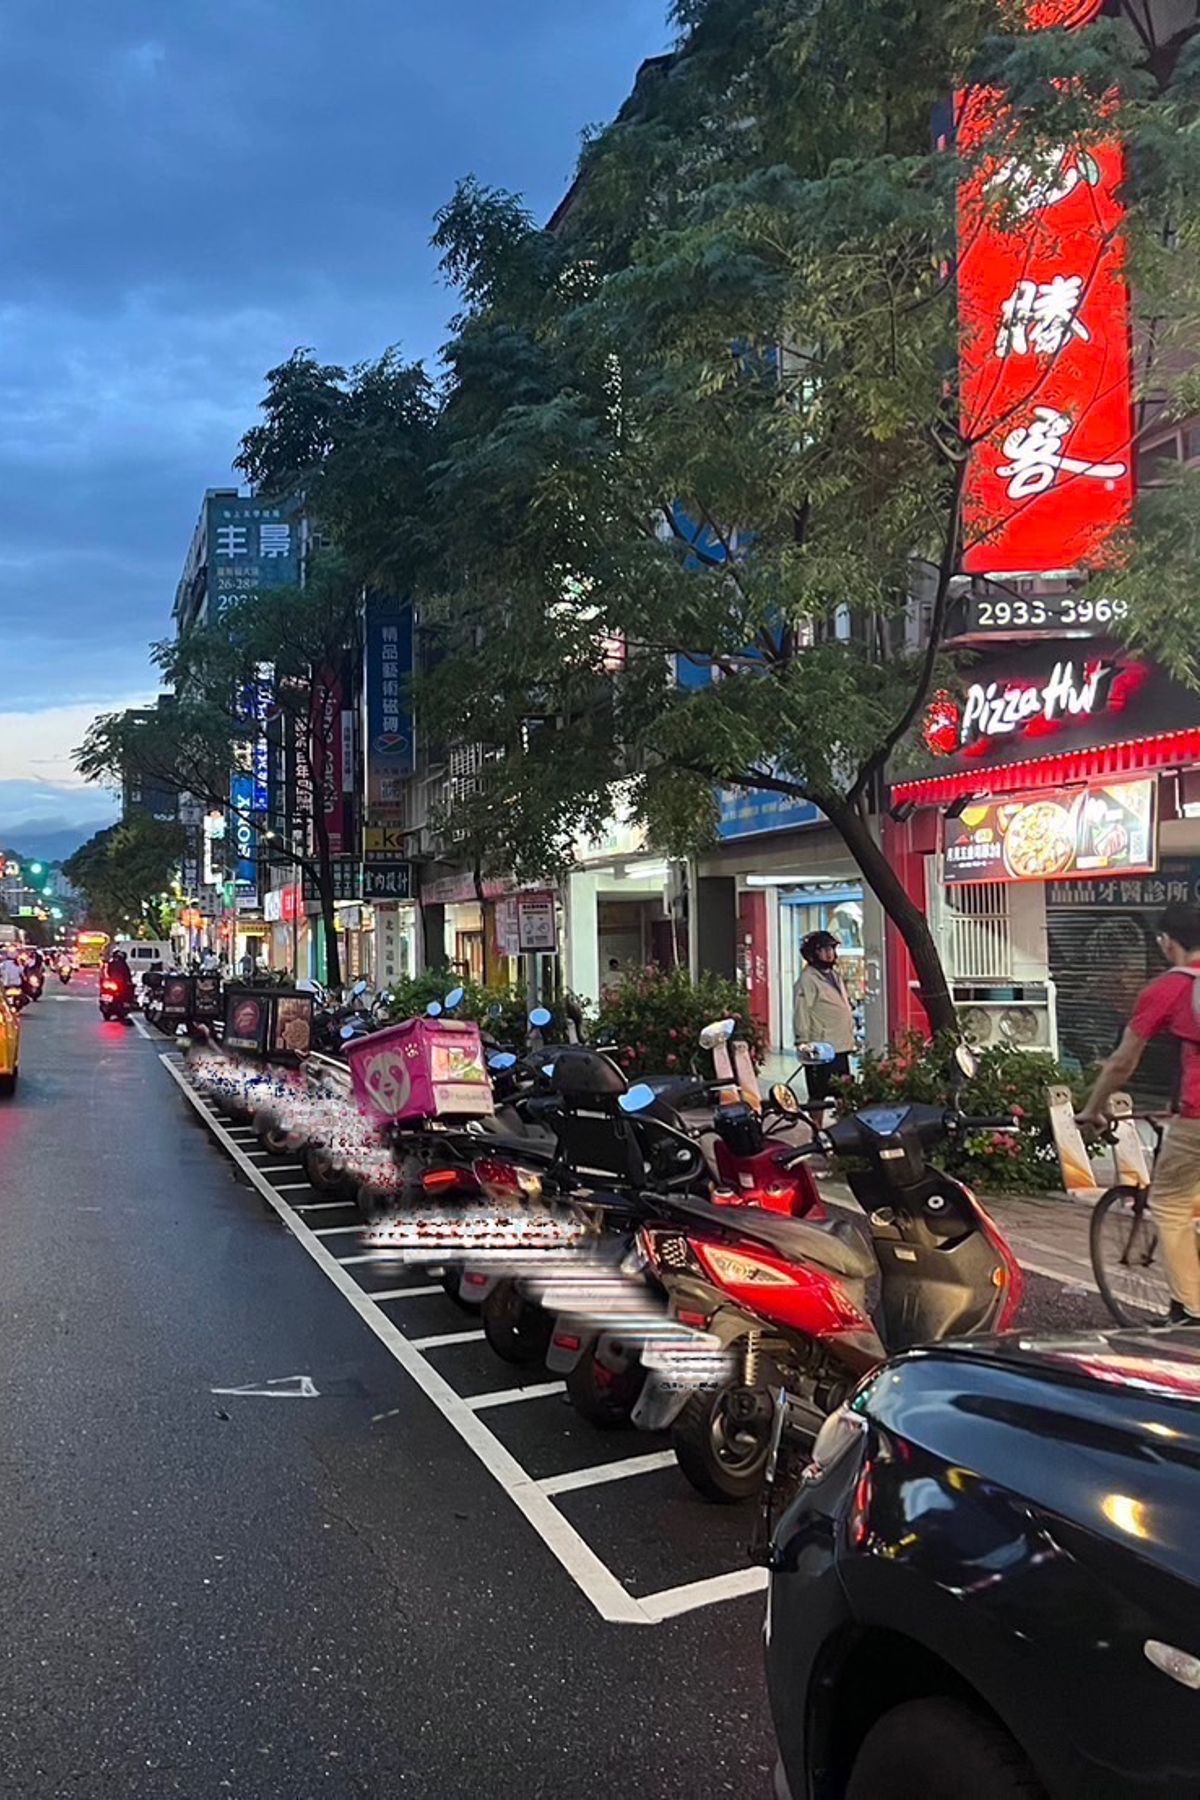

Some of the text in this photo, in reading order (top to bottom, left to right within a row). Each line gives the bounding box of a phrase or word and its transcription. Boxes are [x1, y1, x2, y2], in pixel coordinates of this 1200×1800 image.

[216, 524, 291, 558] 丰景
[960, 660, 1112, 744] Pizza Hut
[365, 871, 408, 892] 室內設計
